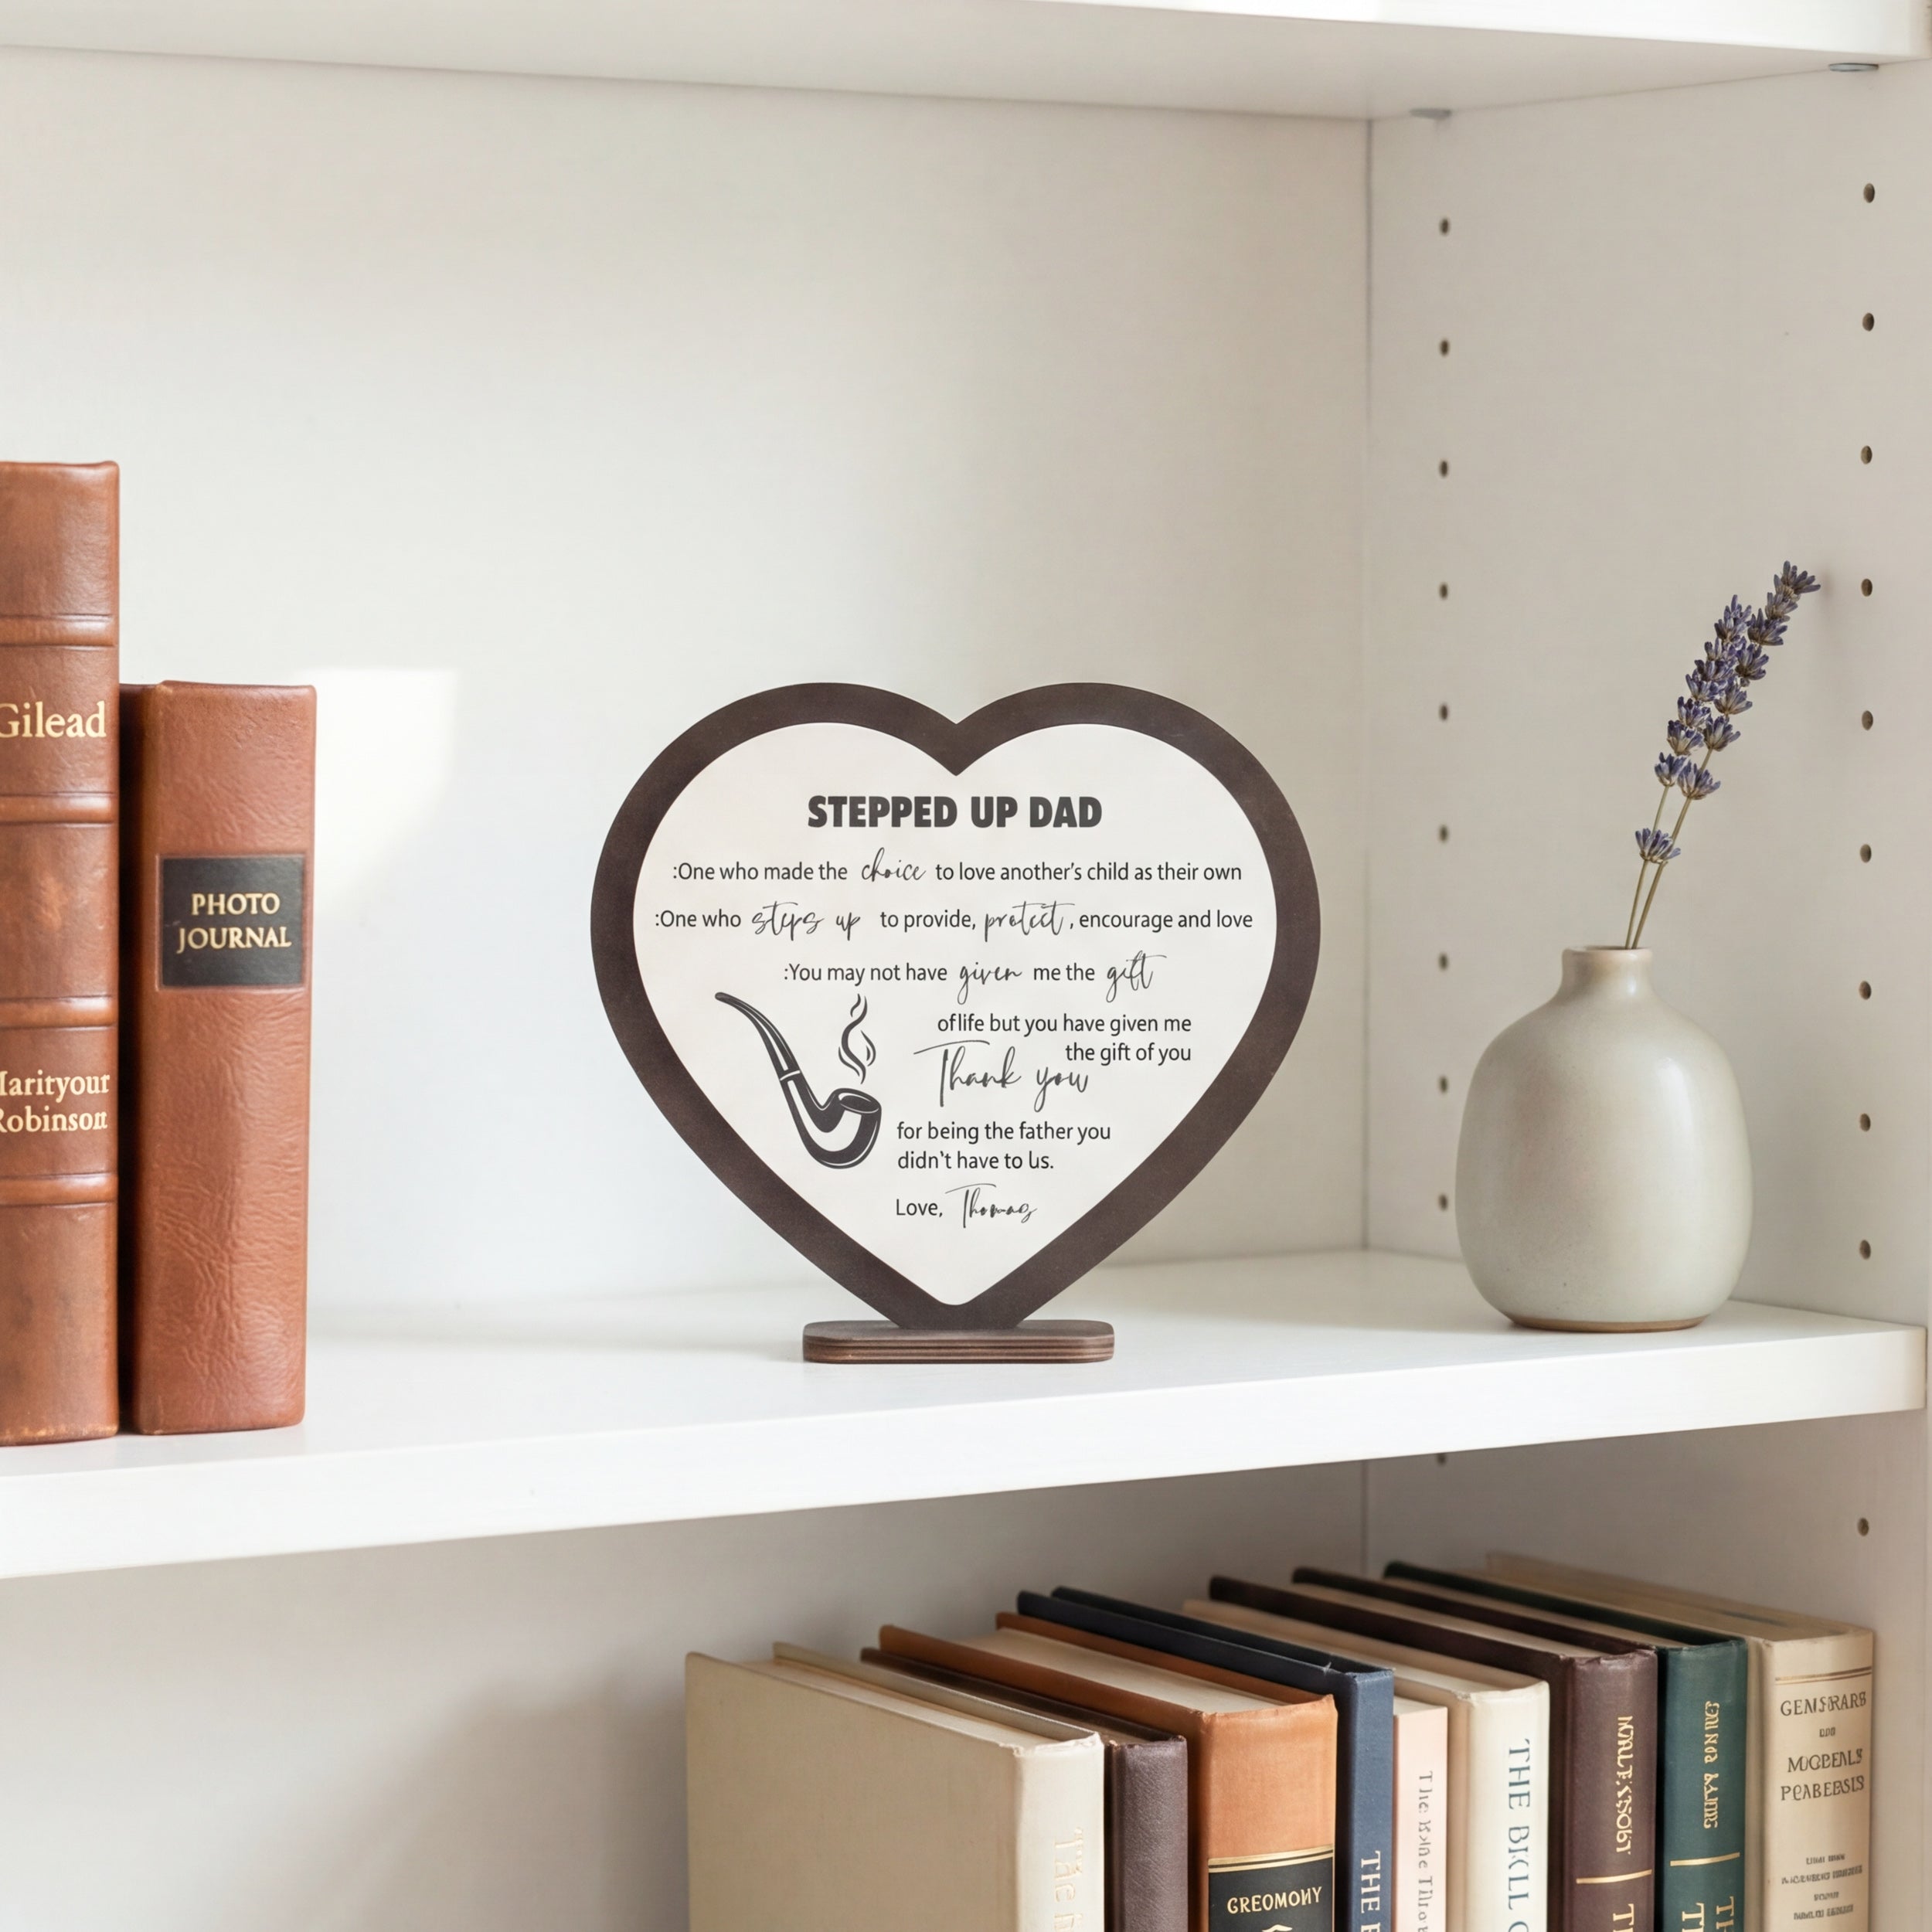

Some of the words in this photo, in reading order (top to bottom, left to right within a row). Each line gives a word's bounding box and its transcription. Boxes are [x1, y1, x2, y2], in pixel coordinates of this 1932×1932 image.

[0, 700, 107, 739] Gilead
[807, 794, 958, 828] STEPPED
[971, 795, 1019, 828] UP
[1029, 796, 1103, 828] DAD
[719, 860, 759, 880] who
[764, 861, 815, 880] made
[818, 860, 848, 881] the
[861, 846, 927, 883] choice
[934, 863, 954, 881] to
[959, 861, 995, 881] love
[1000, 861, 1083, 881] another's
[1087, 861, 1129, 881] child
[1134, 866, 1153, 881] as
[1156, 861, 1199, 881] their
[1203, 866, 1242, 881] own
[191, 892, 281, 916] PHOTO
[702, 908, 742, 928] who
[751, 900, 825, 942] steps
[835, 911, 861, 942] up
[879, 911, 900, 928] to
[903, 908, 976, 934] provide,
[1079, 914, 1174, 934] encourage
[1177, 909, 1211, 928] and
[1216, 909, 1253, 928] love
[175, 926, 293, 954] JOURNAL
[827, 967, 866, 987] may
[870, 964, 901, 981] not
[906, 961, 948, 981] have
[957, 961, 1023, 1005] given
[1033, 967, 1061, 981] me
[1065, 961, 1096, 981] the
[1105, 950, 1168, 1003] gift
[989, 1012, 1021, 1032] but
[1023, 1018, 1058, 1038] you
[1063, 1012, 1105, 1032] have
[1110, 1014, 1158, 1037] given
[1164, 1018, 1192, 1032] me
[1064, 1041, 1096, 1062] the
[1100, 1042, 1131, 1066] gift
[1135, 1042, 1155, 1061] of
[1157, 1047, 1192, 1066] you
[913, 1039, 1022, 1108] Thank
[1033, 1066, 1089, 1114] you
[896, 1121, 923, 1140] for
[927, 1121, 979, 1145] being
[984, 1121, 1015, 1140] the
[1019, 1121, 1074, 1140] father
[1077, 1126, 1111, 1146] you
[957, 1150, 999, 1169] have
[1003, 1152, 1023, 1170] to
[896, 1198, 944, 1218] Love,
[945, 1182, 1038, 1229] Thomas
[1508, 1738, 1531, 1810] THE
[1360, 1849, 1381, 1913] THE
